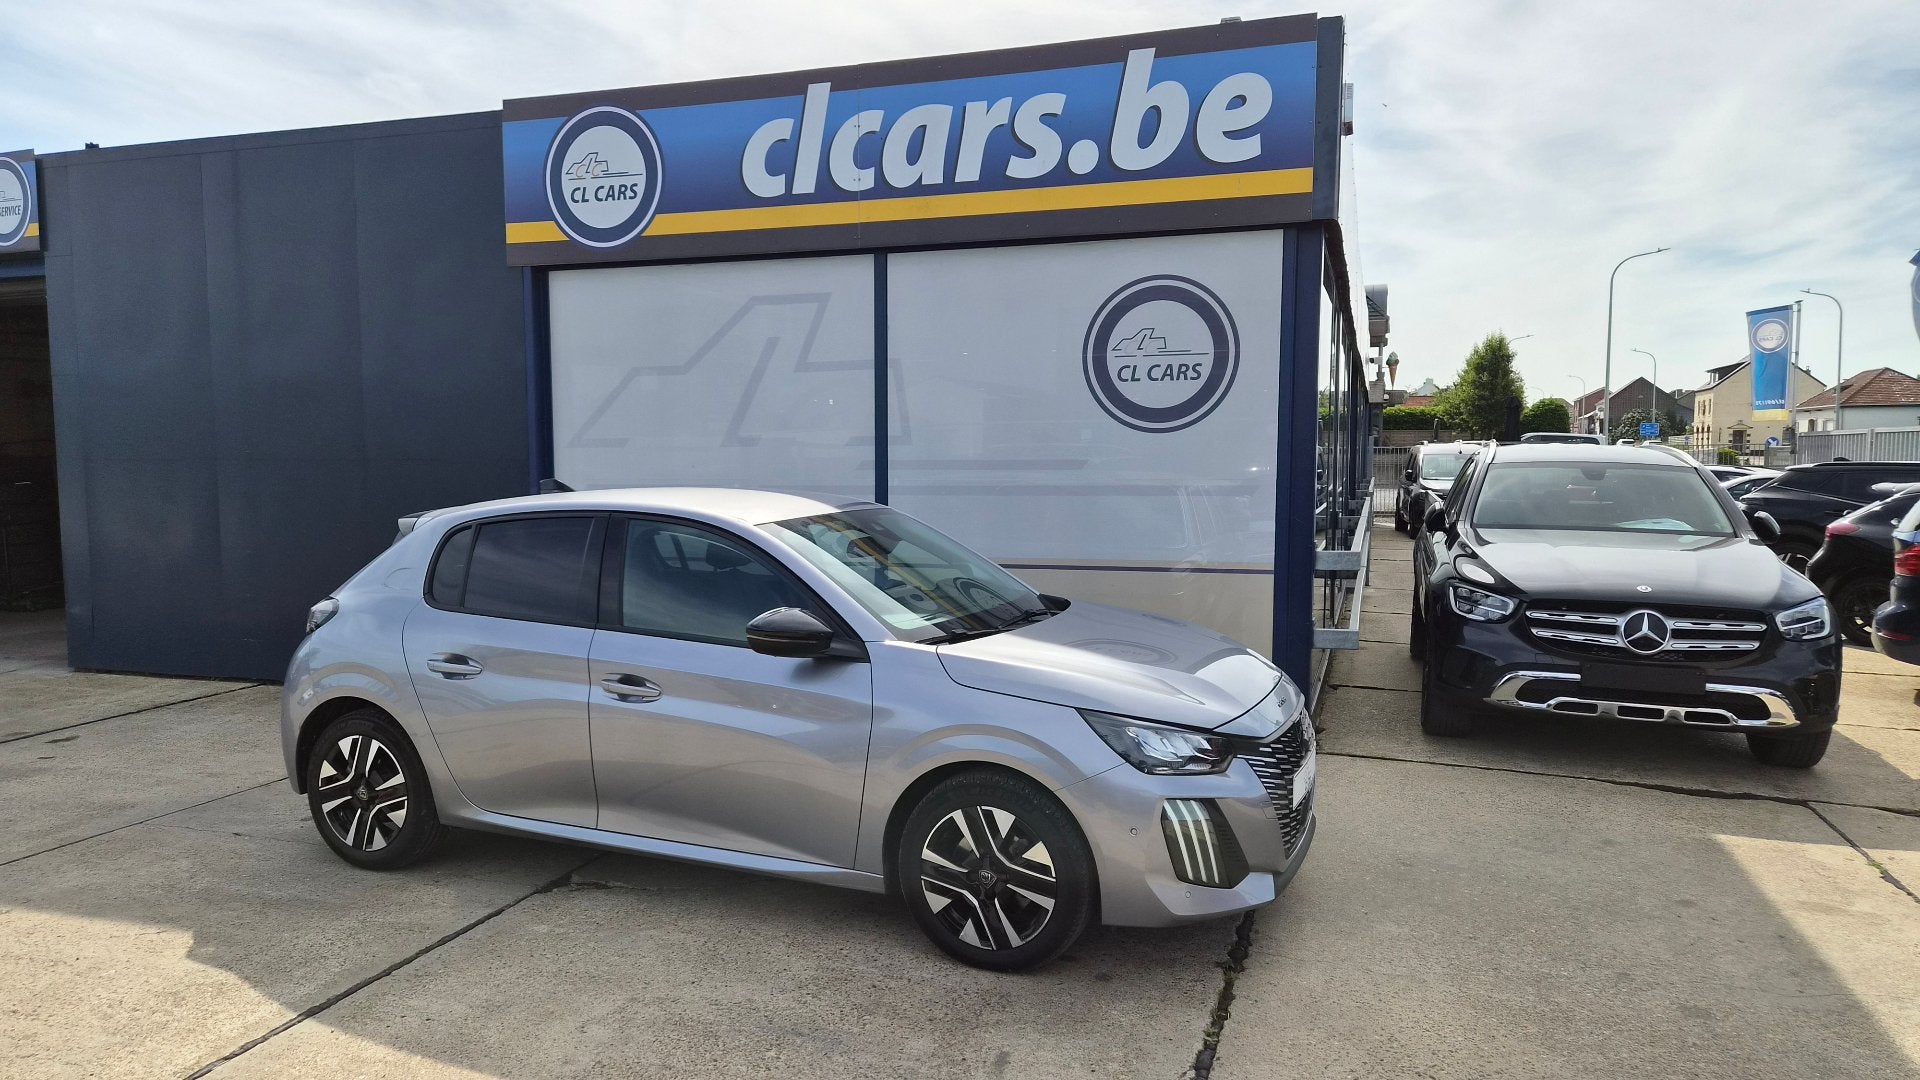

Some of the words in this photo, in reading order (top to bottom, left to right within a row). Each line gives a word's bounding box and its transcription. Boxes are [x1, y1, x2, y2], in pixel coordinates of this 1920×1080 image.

[742, 49, 1273, 198] clcars.be
[571, 186, 590, 203] CL
[594, 183, 638, 202] CARS
[1117, 364, 1141, 383] CL
[1146, 363, 1203, 382] CARS
